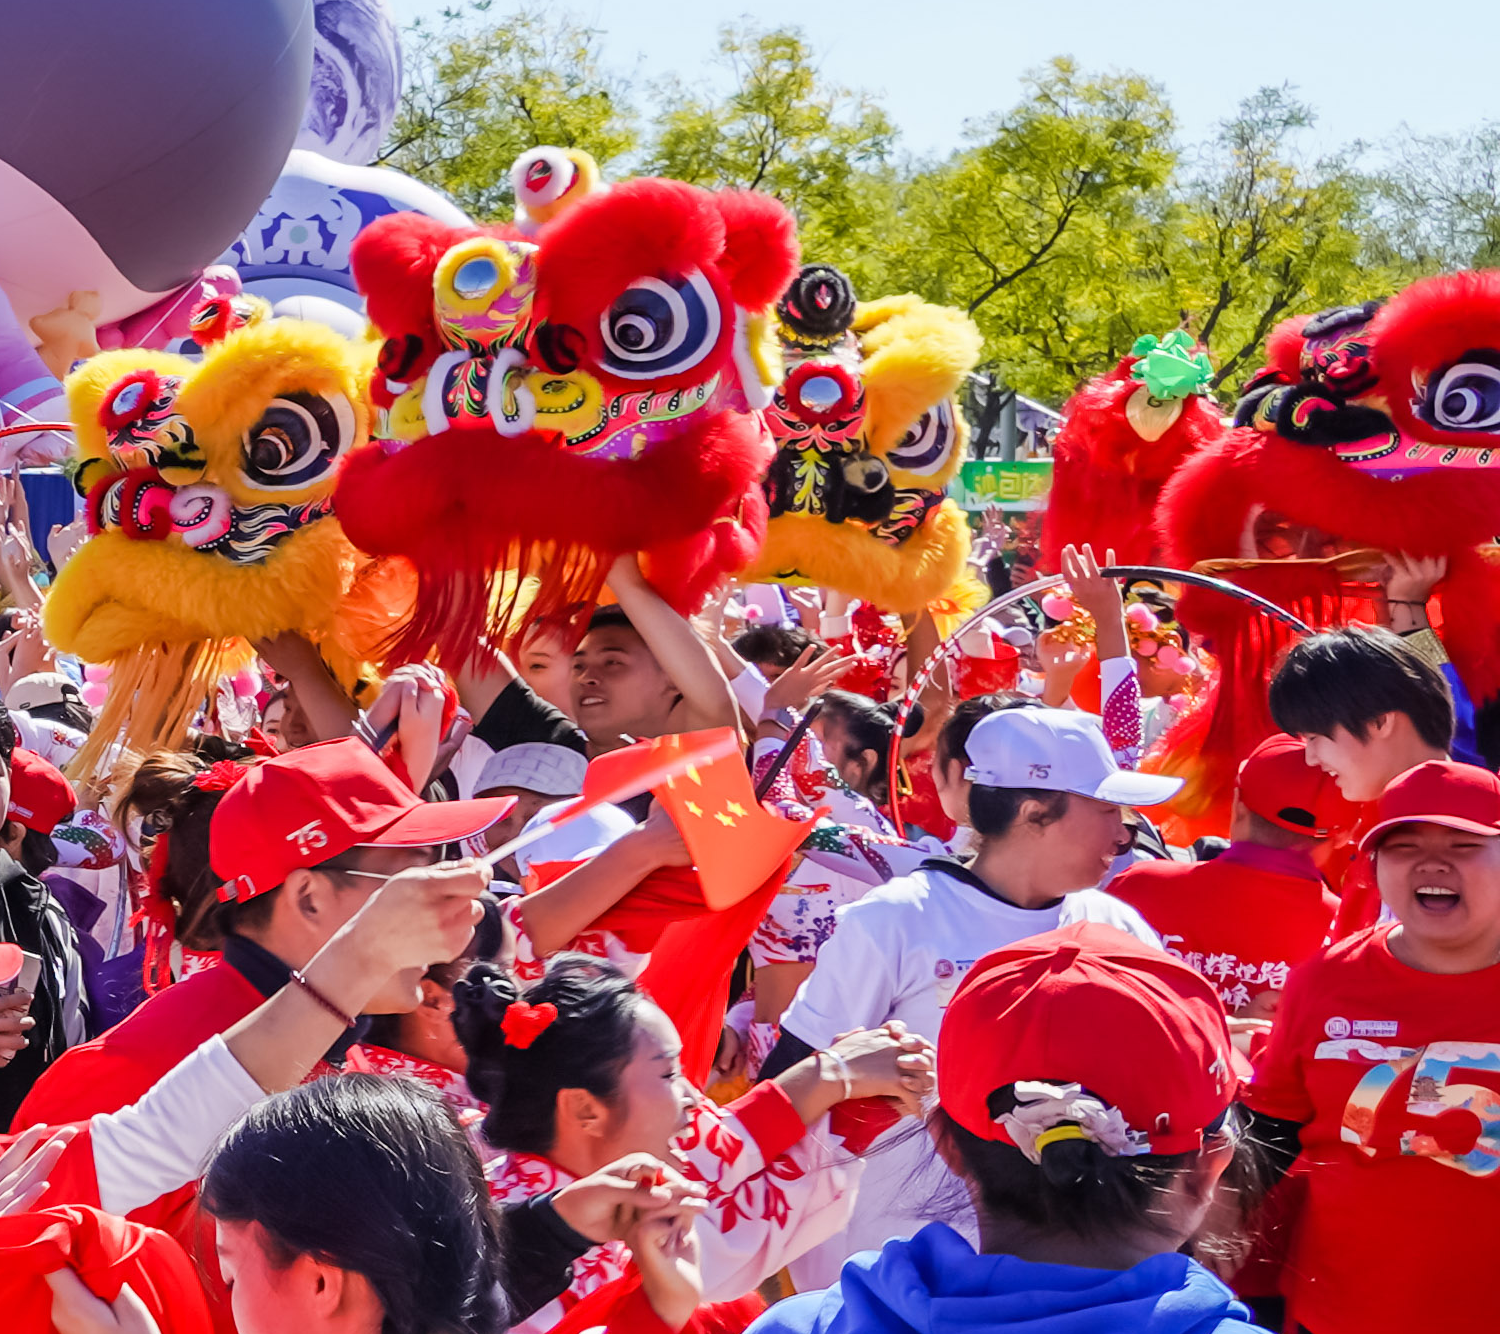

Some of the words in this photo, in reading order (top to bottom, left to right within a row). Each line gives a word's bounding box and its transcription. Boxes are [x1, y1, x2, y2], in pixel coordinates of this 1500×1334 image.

[1028, 763, 1051, 779] 75
[286, 819, 327, 855] 75
[1314, 1038, 1500, 1178] 75
